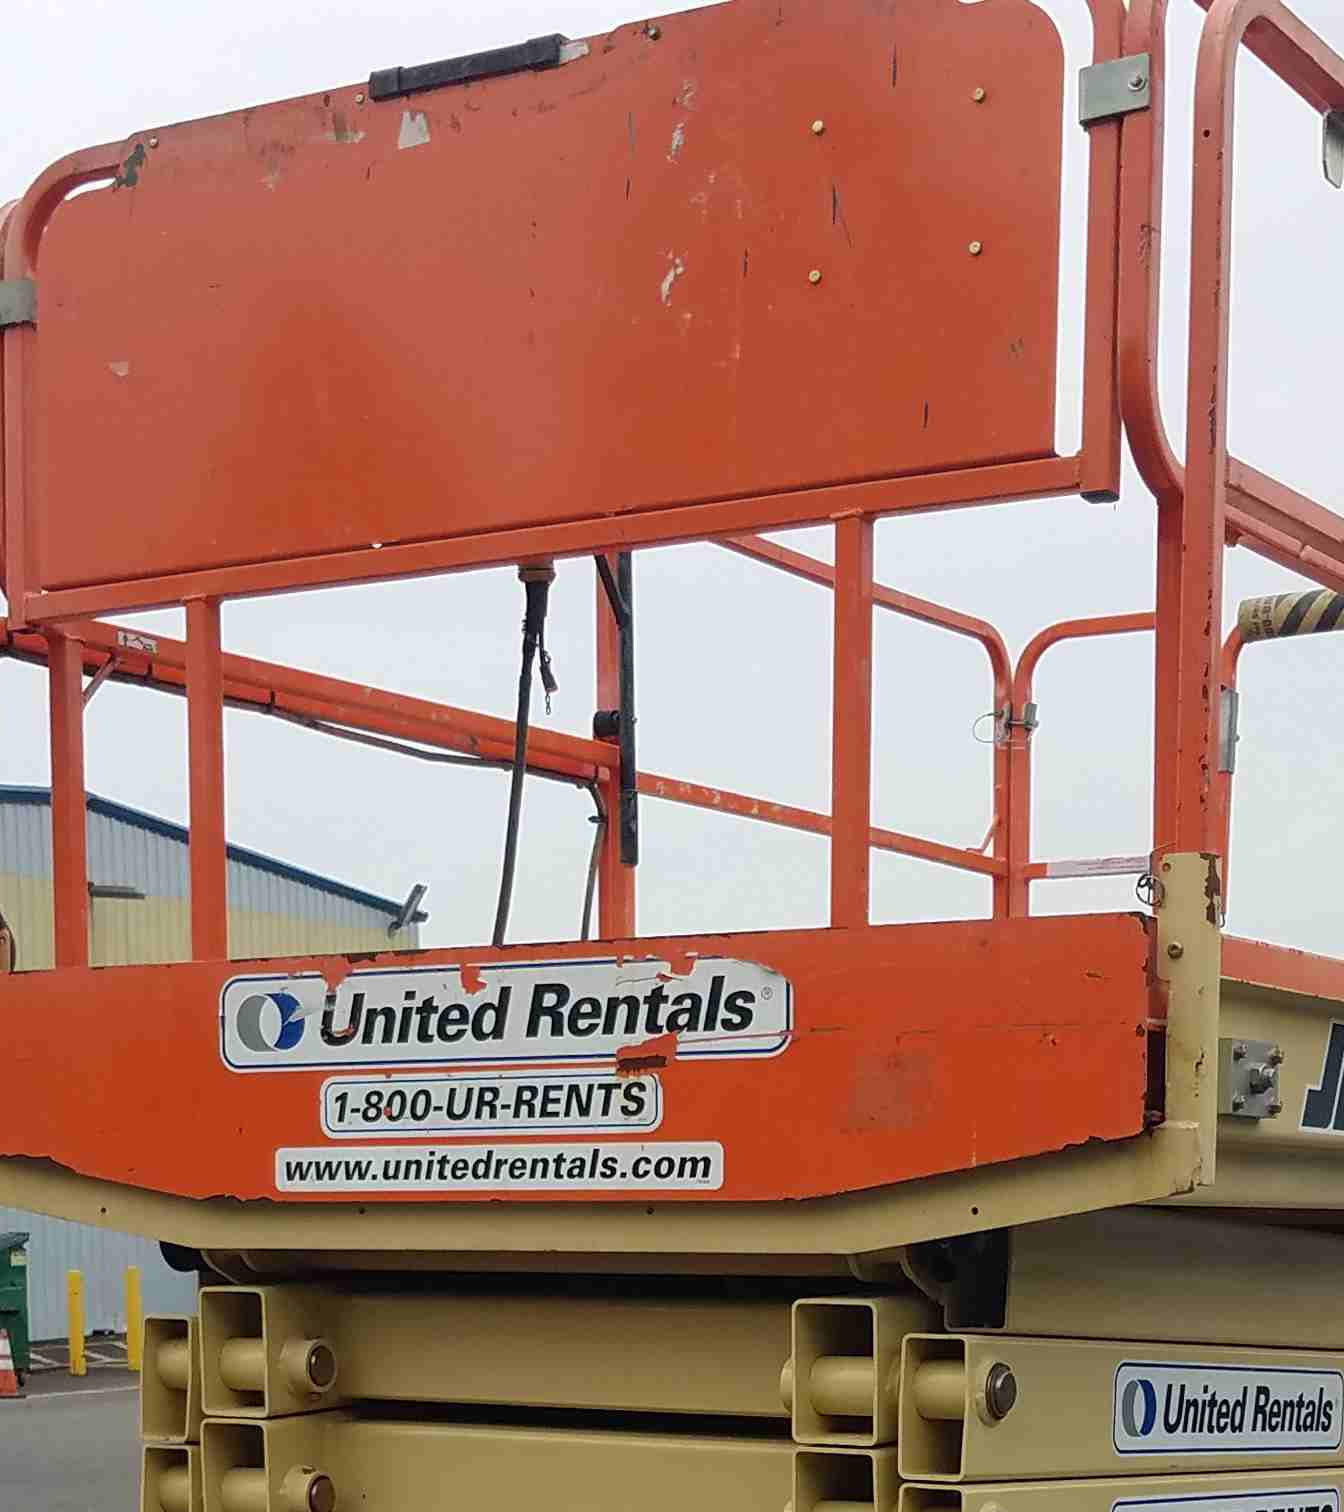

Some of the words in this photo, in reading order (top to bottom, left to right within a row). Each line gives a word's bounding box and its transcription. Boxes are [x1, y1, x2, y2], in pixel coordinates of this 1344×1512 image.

[320, 985, 513, 1047] United
[526, 975, 755, 1038] Rentals
[332, 1079, 647, 1124] 1-800-UR-RENTS
[284, 1146, 713, 1184] www.unitedrentals.com
[1163, 1383, 1247, 1434] United
[1251, 1385, 1334, 1433] Rentals
